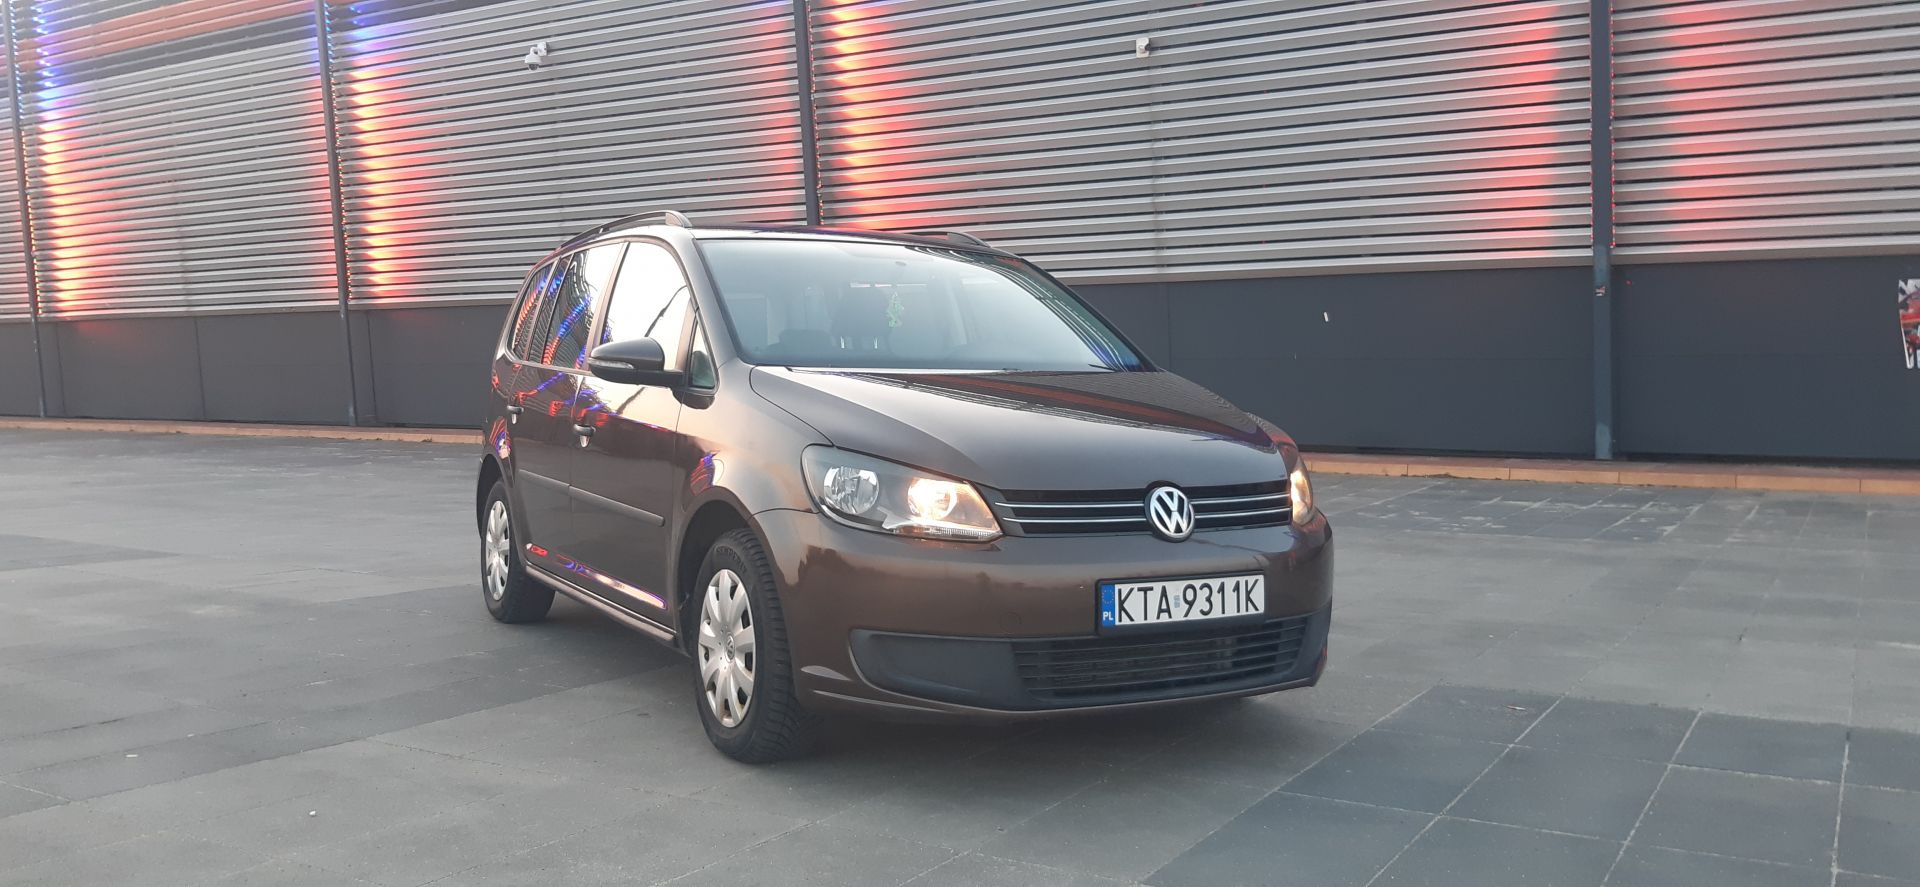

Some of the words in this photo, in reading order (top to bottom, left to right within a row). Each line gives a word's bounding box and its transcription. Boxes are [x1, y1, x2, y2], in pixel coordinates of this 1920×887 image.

[1117, 585, 1172, 623] KTA
[1182, 578, 1260, 618] 9311K
[1102, 611, 1114, 621] PL
